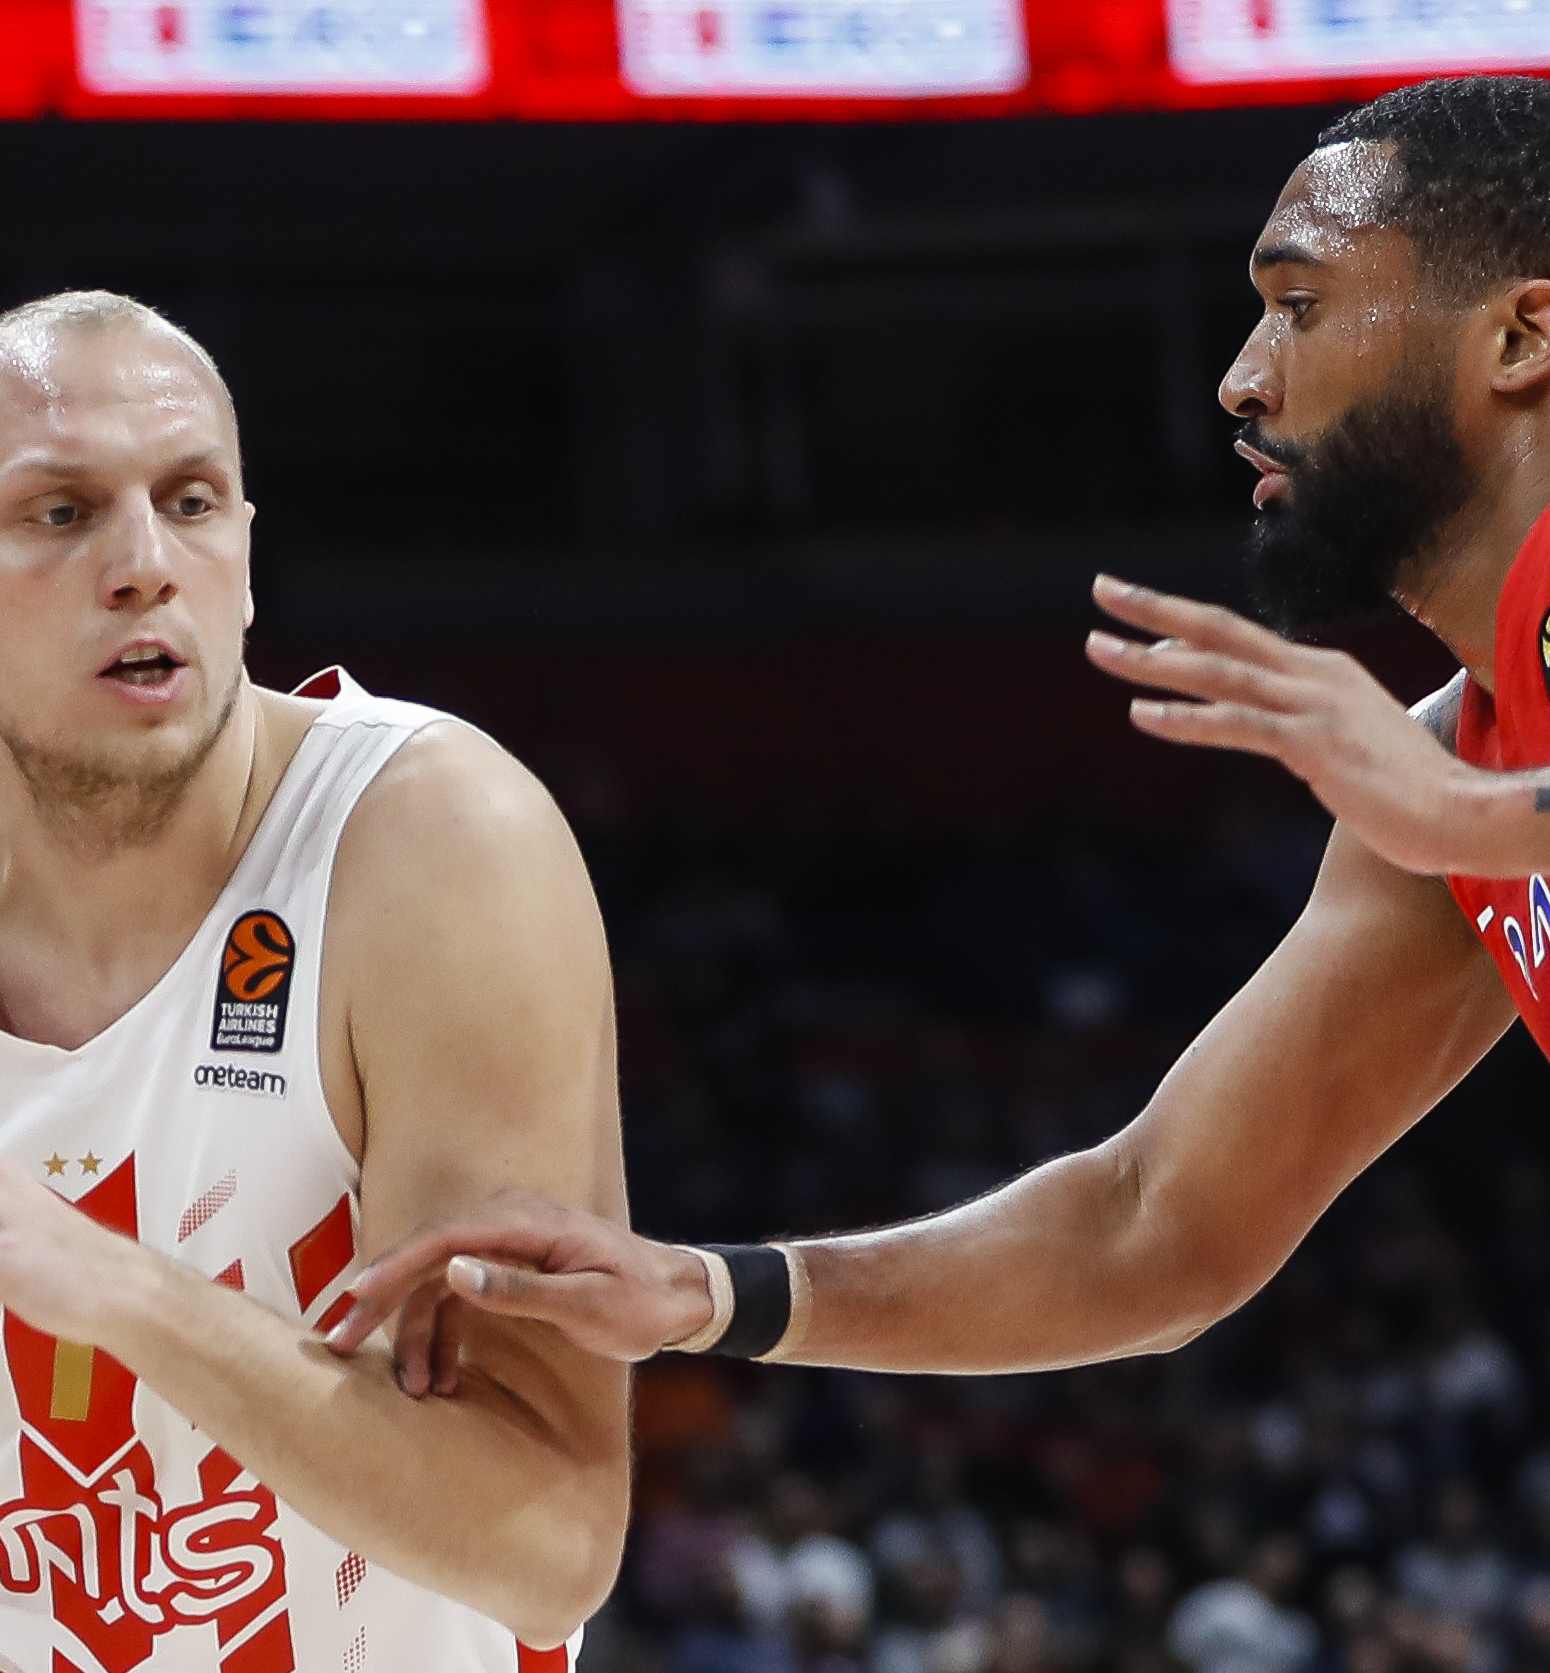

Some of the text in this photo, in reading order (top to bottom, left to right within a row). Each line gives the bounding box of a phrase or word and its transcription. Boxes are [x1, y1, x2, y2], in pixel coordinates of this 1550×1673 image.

[220, 1002, 279, 1019] TURKISH
[218, 1017, 277, 1034] AIRLINES
[193, 1062, 286, 1096] oneteam
